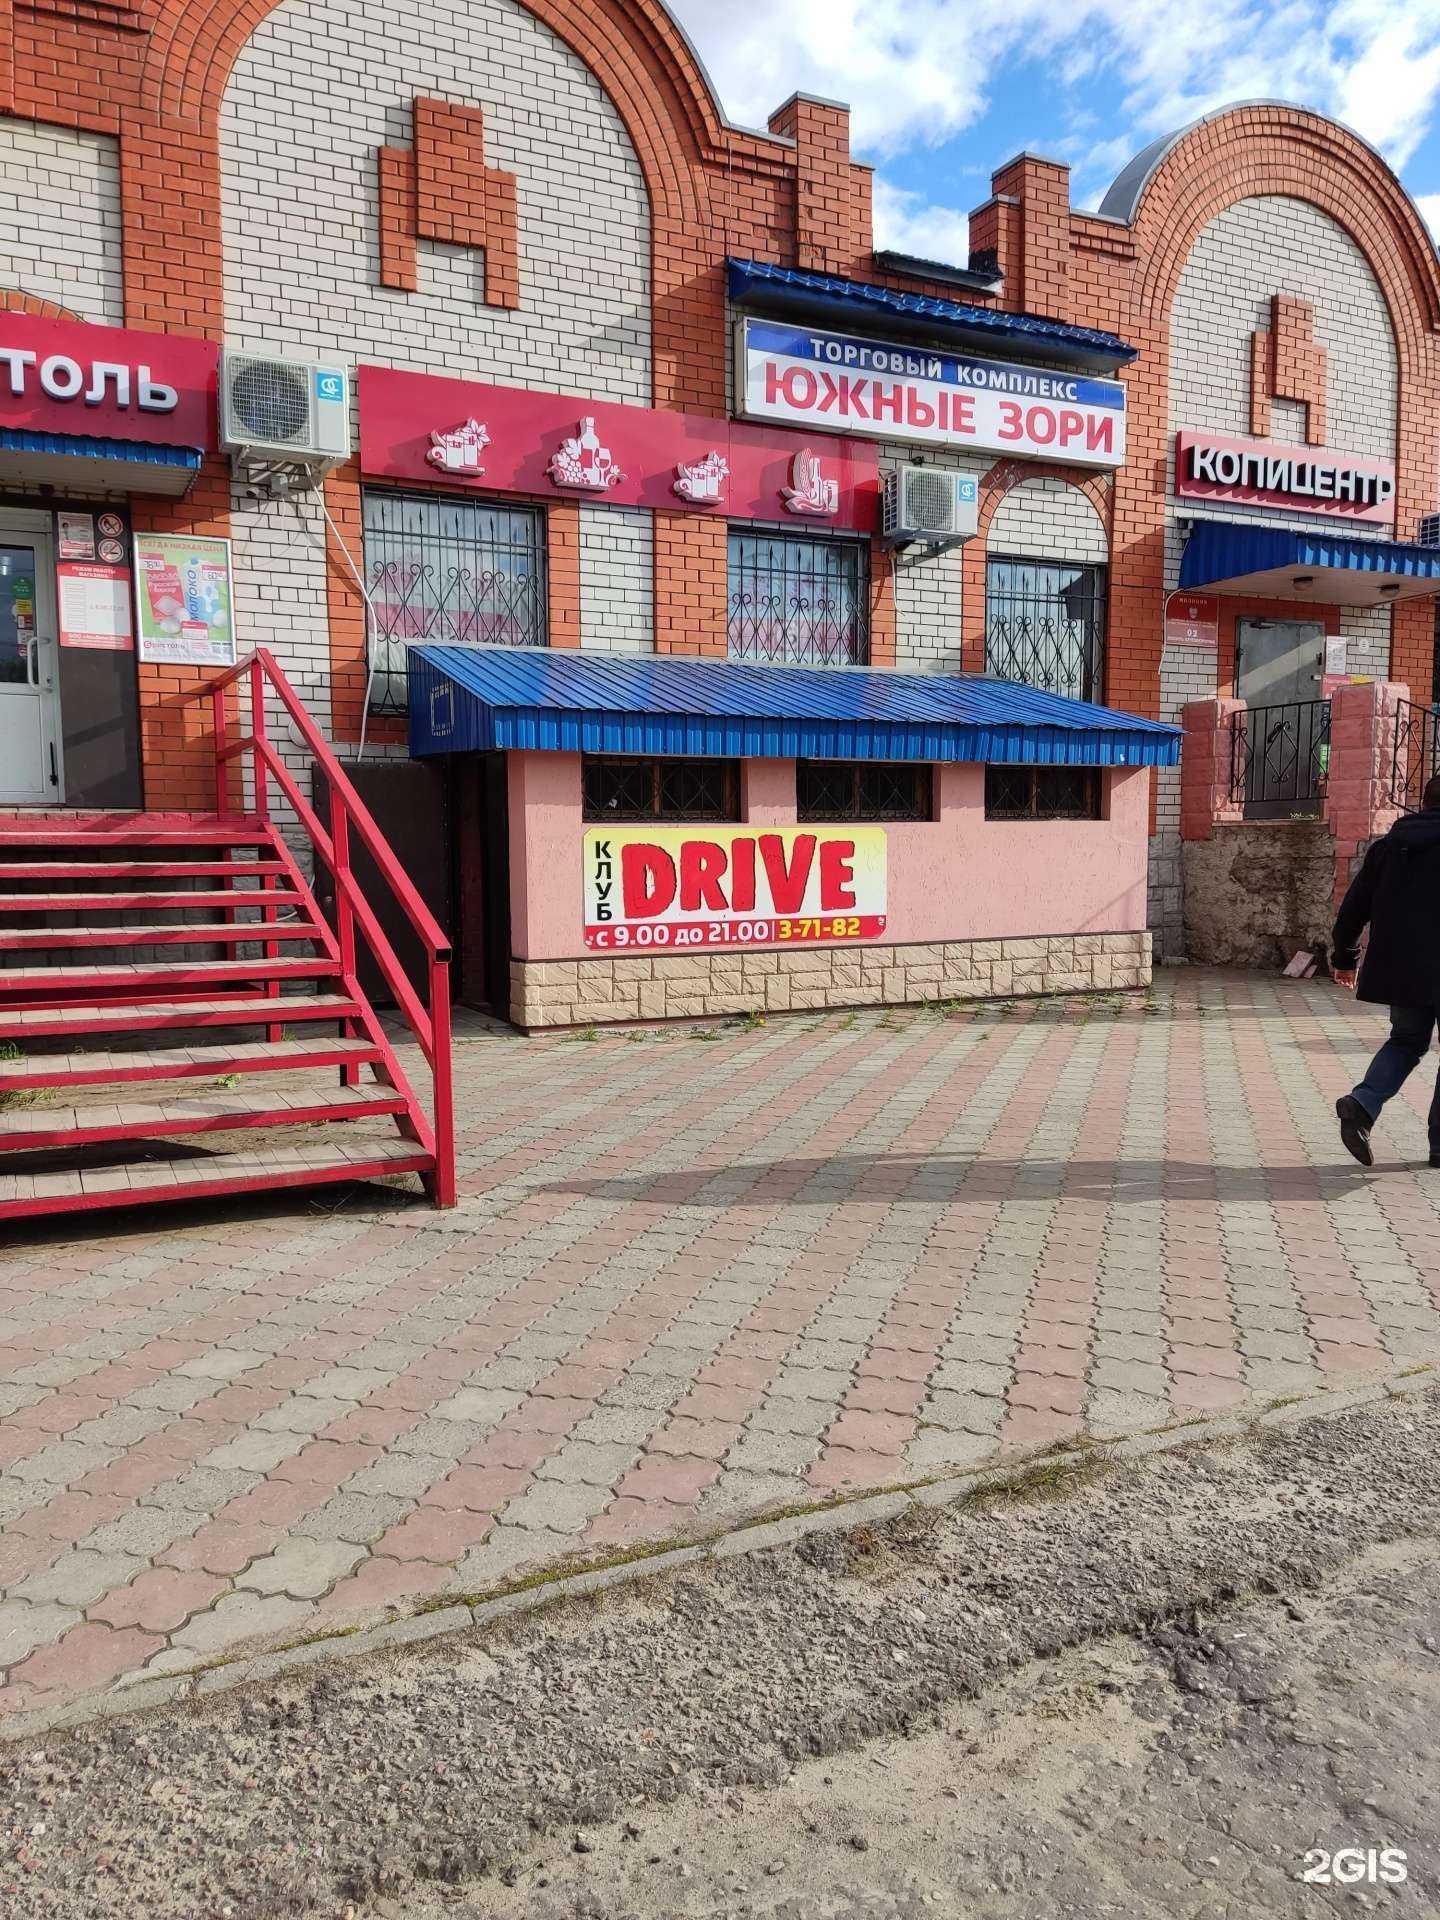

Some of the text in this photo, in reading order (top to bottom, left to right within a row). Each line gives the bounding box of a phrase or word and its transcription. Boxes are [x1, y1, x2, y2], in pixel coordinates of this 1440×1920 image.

[810, 338, 1078, 400] ТОРГОВЫЙ КОМПЛЕКС
[766, 362, 1113, 453] ЮЖНЫЕ ЗОРИ
[1192, 444, 1396, 505] КОПИЦЕНТР
[595, 841, 612, 921] КЛУБ
[621, 834, 856, 919] DRIVE
[614, 925, 669, 945] 9.00
[675, 928, 703, 945] до
[709, 921, 769, 942] 21.00
[778, 918, 861, 939] 3-71-82
